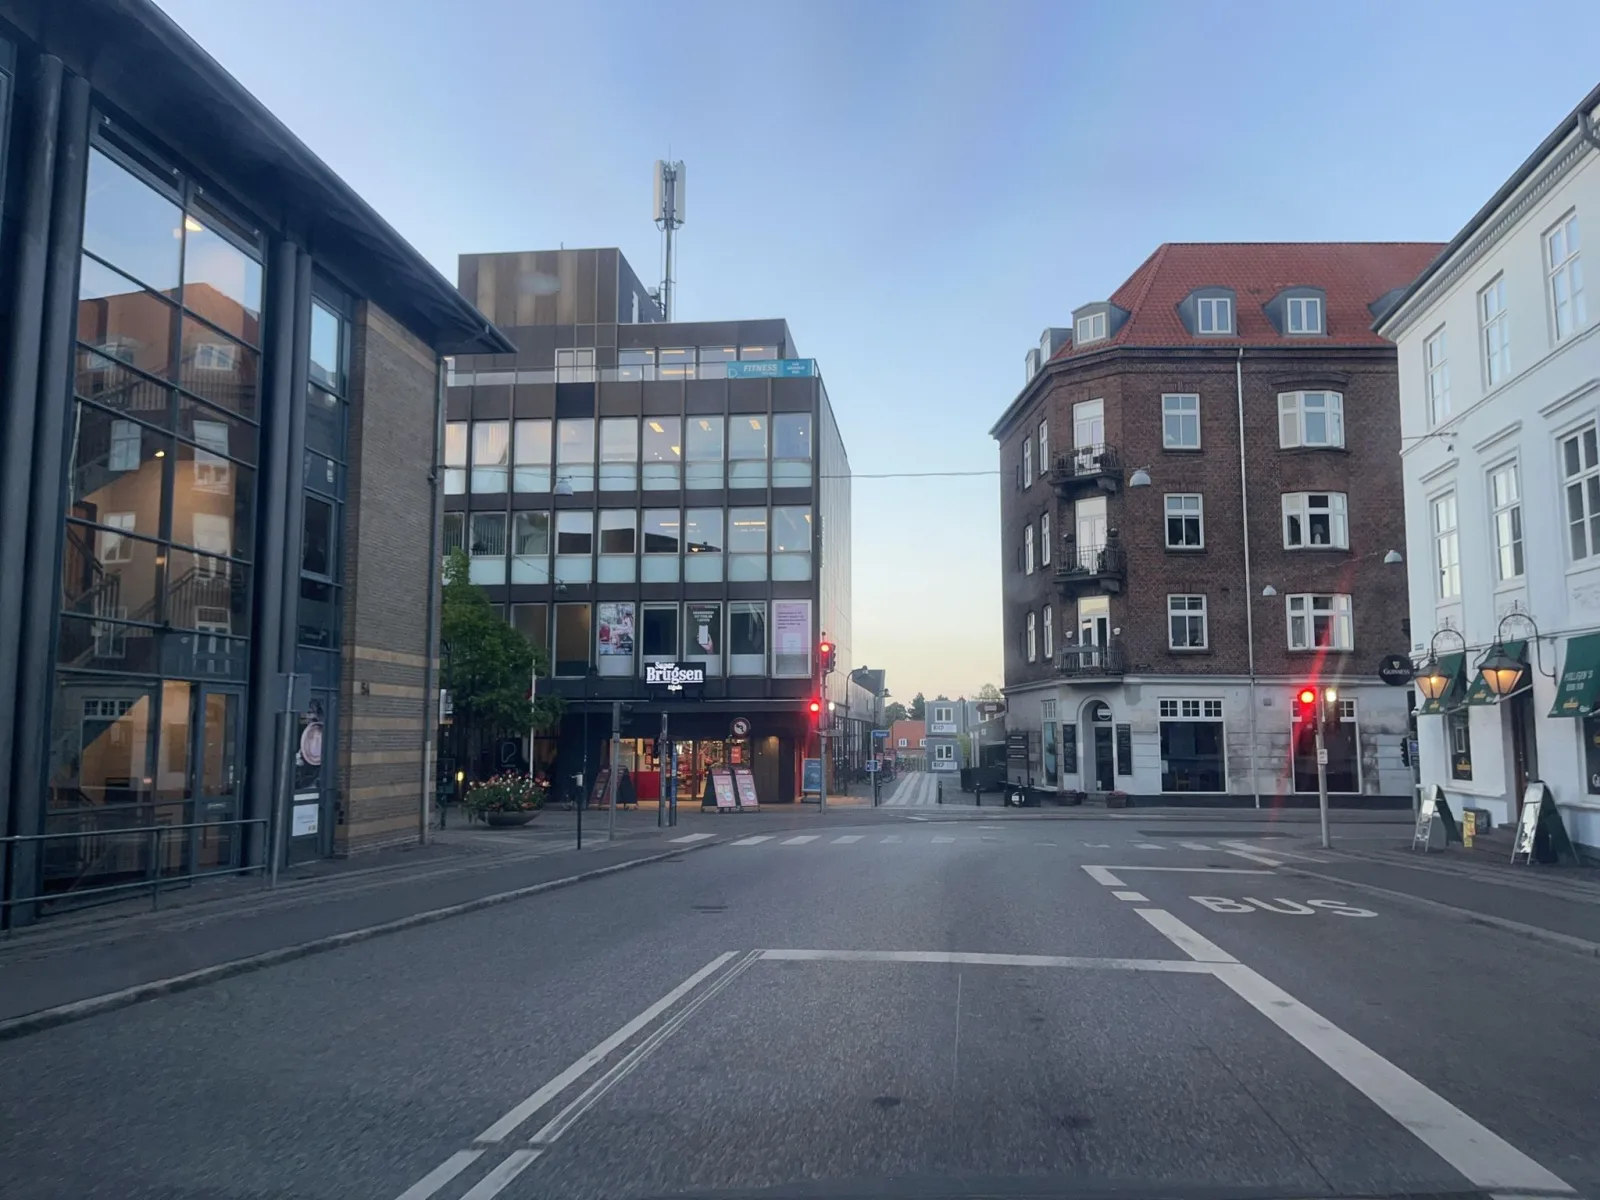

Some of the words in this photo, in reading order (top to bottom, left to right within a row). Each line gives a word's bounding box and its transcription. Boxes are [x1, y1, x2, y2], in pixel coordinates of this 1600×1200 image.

[743, 363, 777, 372] FITNESS
[654, 661, 675, 671] Super
[646, 666, 704, 685] Brugsen
[1188, 895, 1379, 918] BUS
